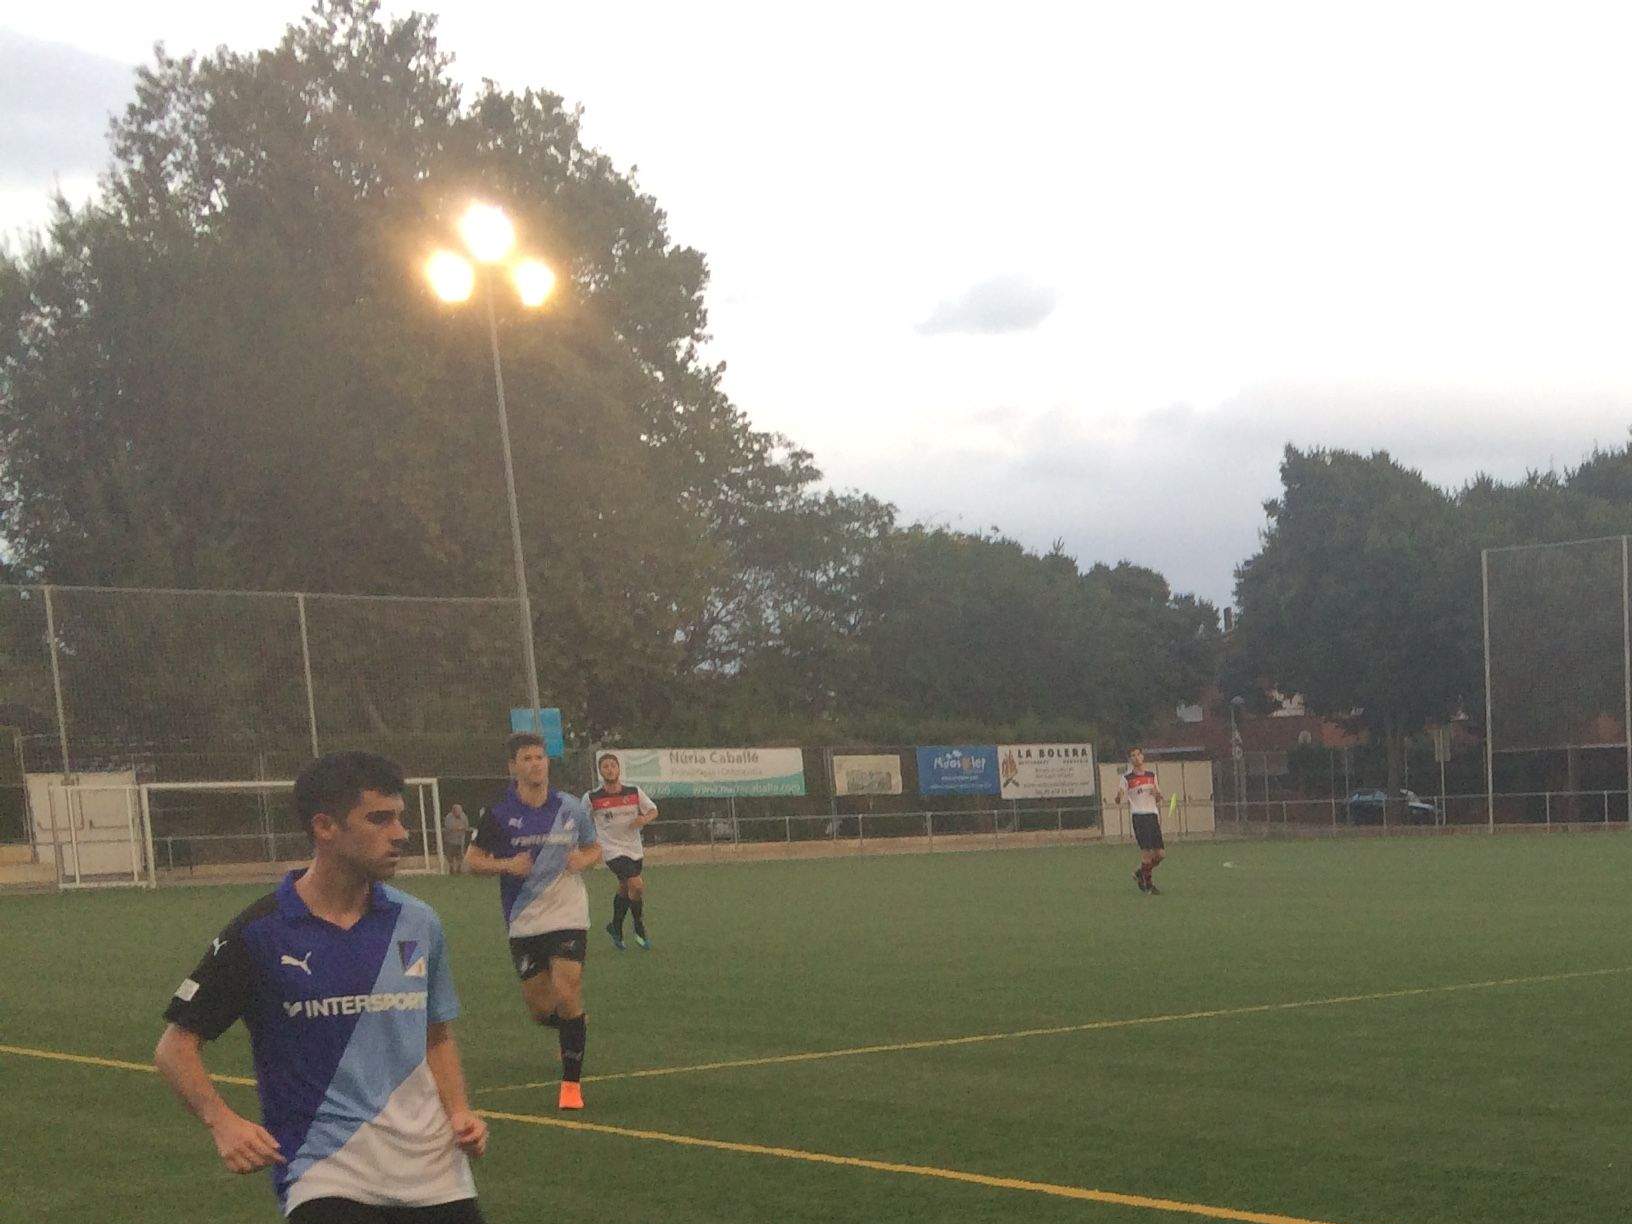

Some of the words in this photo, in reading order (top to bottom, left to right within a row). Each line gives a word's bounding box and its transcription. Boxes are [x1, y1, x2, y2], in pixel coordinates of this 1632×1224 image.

[669, 750, 706, 765] Núria
[1017, 748, 1032, 758] LA
[1039, 748, 1088, 758] BOLERA
[304, 991, 428, 1018] INTERSPORT
